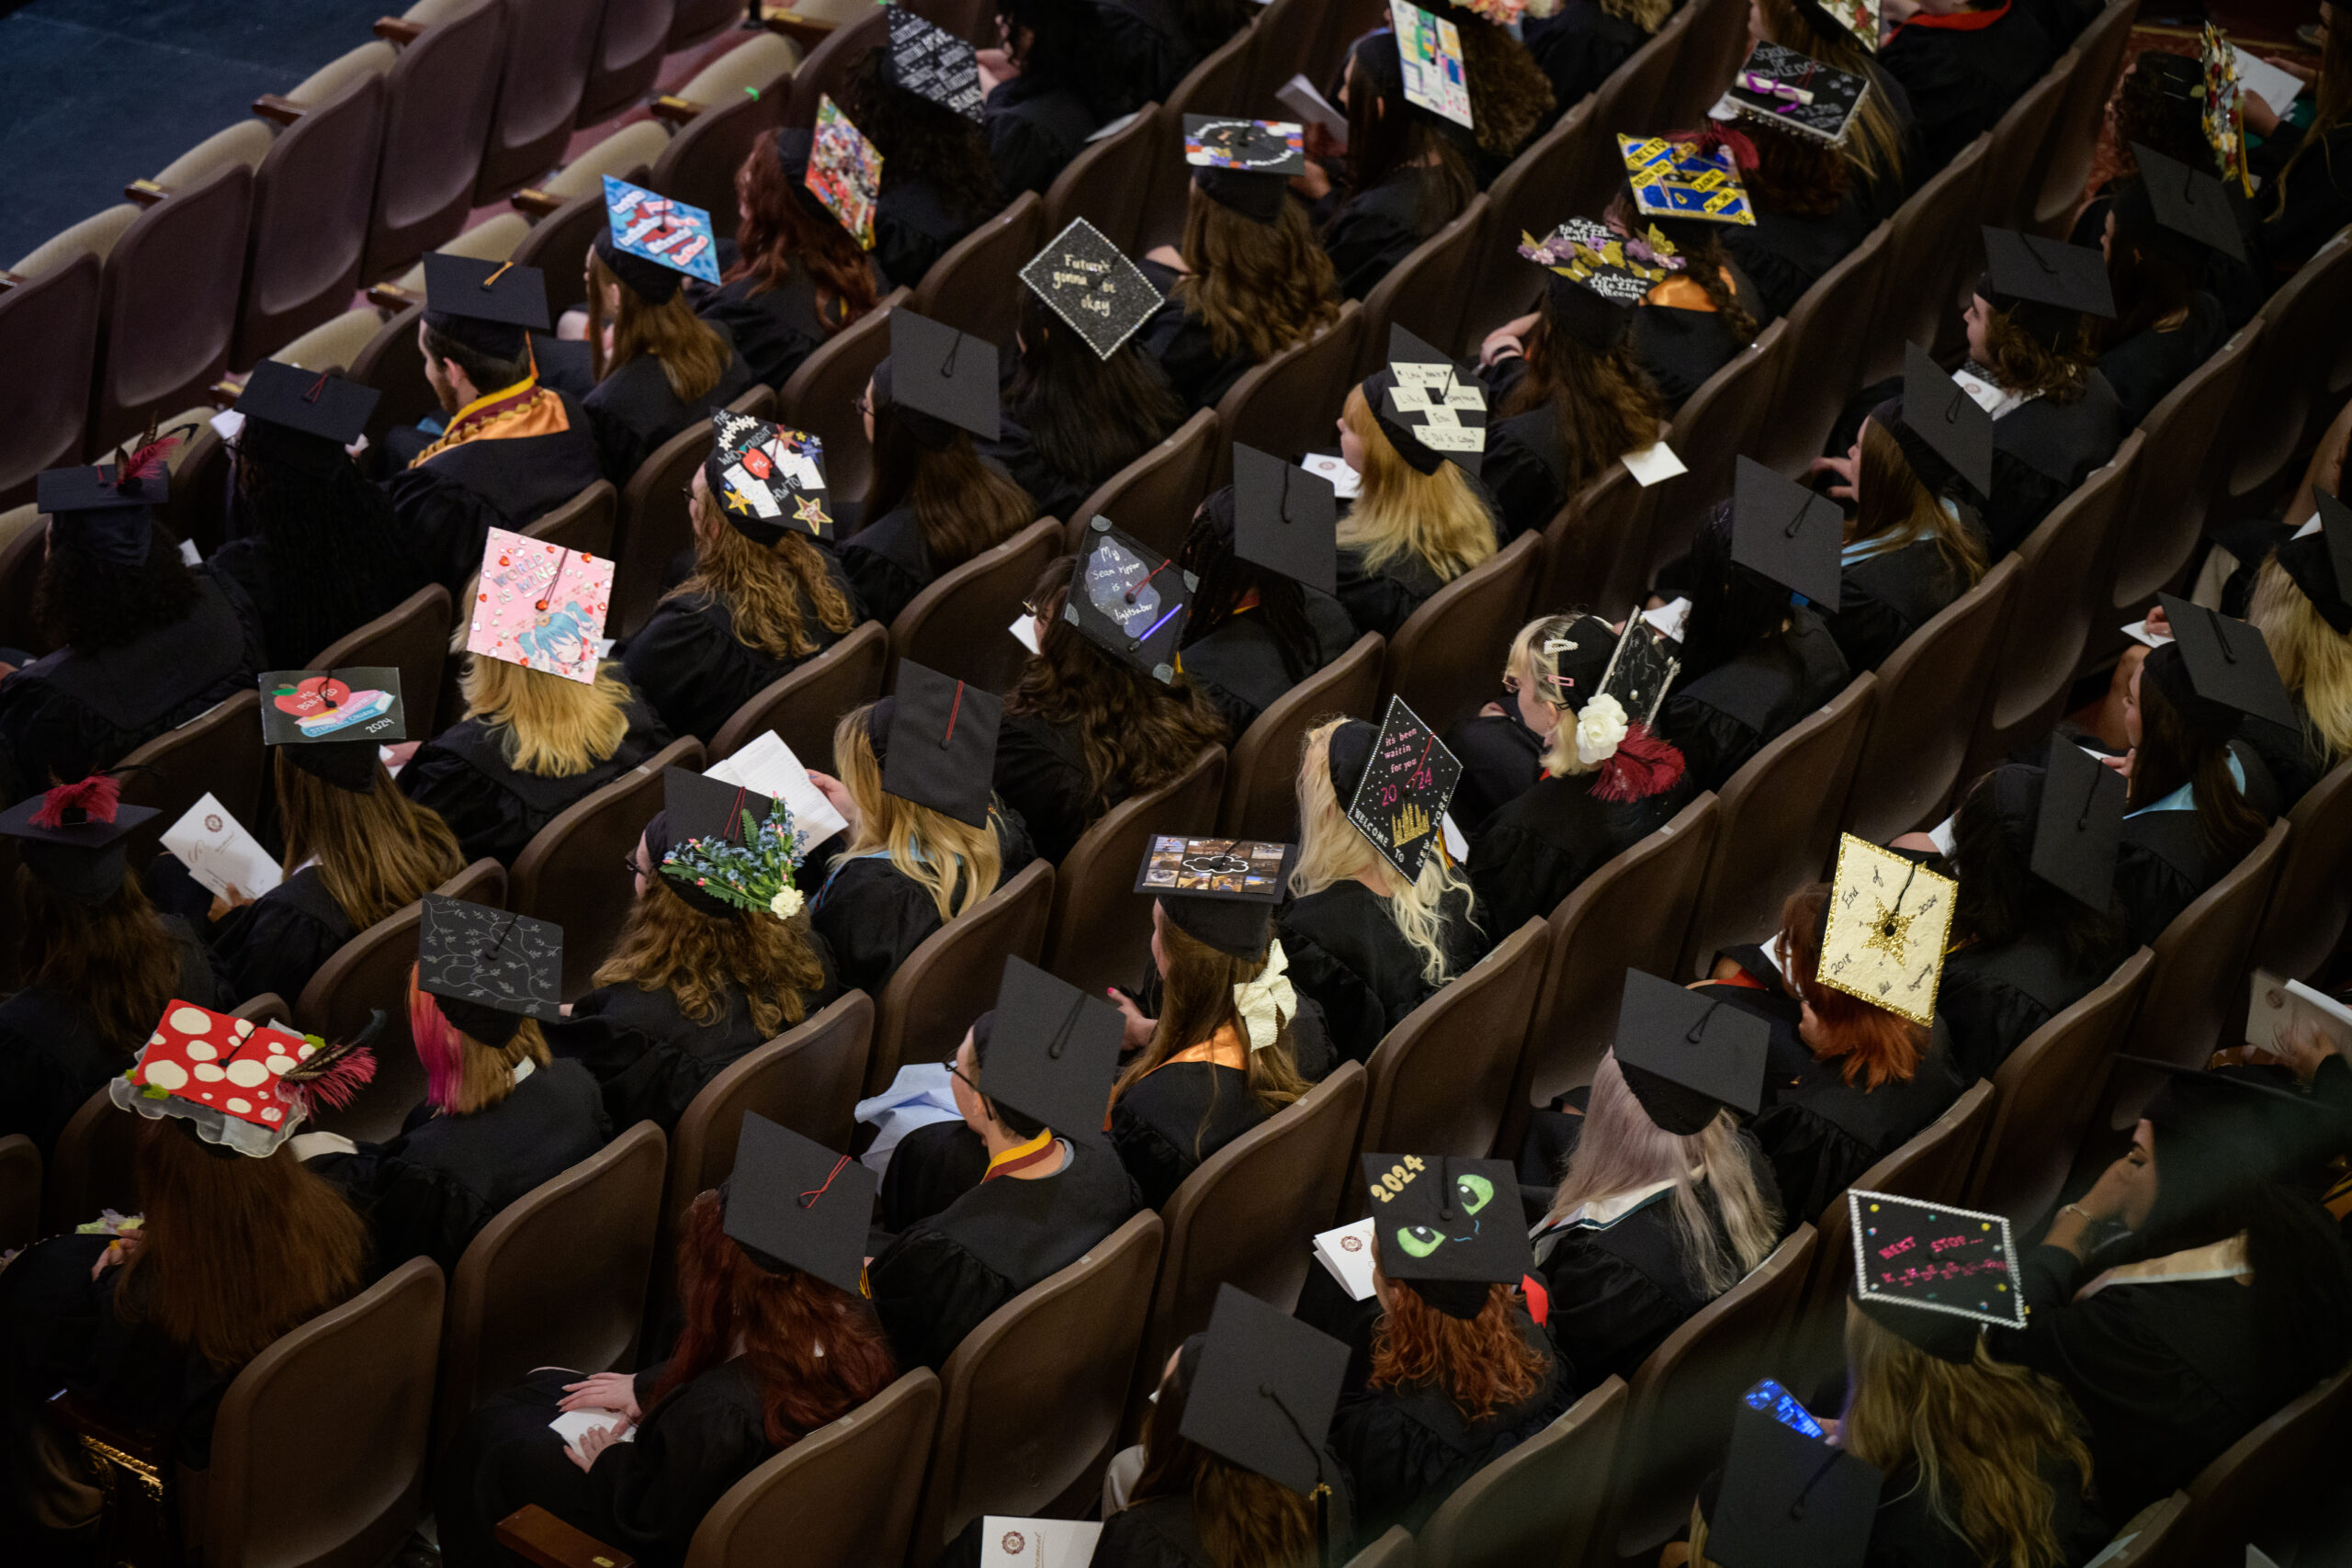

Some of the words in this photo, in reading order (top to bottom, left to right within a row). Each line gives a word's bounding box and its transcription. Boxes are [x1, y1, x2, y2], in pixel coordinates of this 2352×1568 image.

[1052, 271, 1088, 289] gonna
[1080, 294, 1110, 318] okay
[713, 409, 731, 426] THE
[718, 450, 742, 466] WHO
[744, 425, 772, 449] TAUGHT
[752, 457, 767, 472] ME
[772, 483, 789, 502] HOW
[786, 478, 802, 490] TO
[1101, 547, 1120, 562] My
[492, 552, 545, 587] WORLD
[497, 589, 513, 604] IS
[1111, 583, 1120, 592] is
[1114, 604, 1153, 626] lightsaber
[365, 717, 396, 734] 2024
[1385, 735, 1396, 747] it's
[1399, 728, 1418, 741] been
[1384, 745, 1412, 760] waitin
[1390, 762, 1403, 774] for
[1403, 759, 1418, 773] you
[1380, 784, 1397, 807] 20
[1417, 767, 1432, 791] 24
[1354, 807, 1389, 848] WELCOME
[1395, 848, 1405, 863] TO
[1416, 839, 1430, 868] NEW
[1432, 791, 1450, 827] YORK
[1841, 886, 1860, 909] End
[1830, 953, 1853, 976] 2018
[1370, 1154, 1426, 1203] 2024
[1878, 1235, 1917, 1260] NEXT
